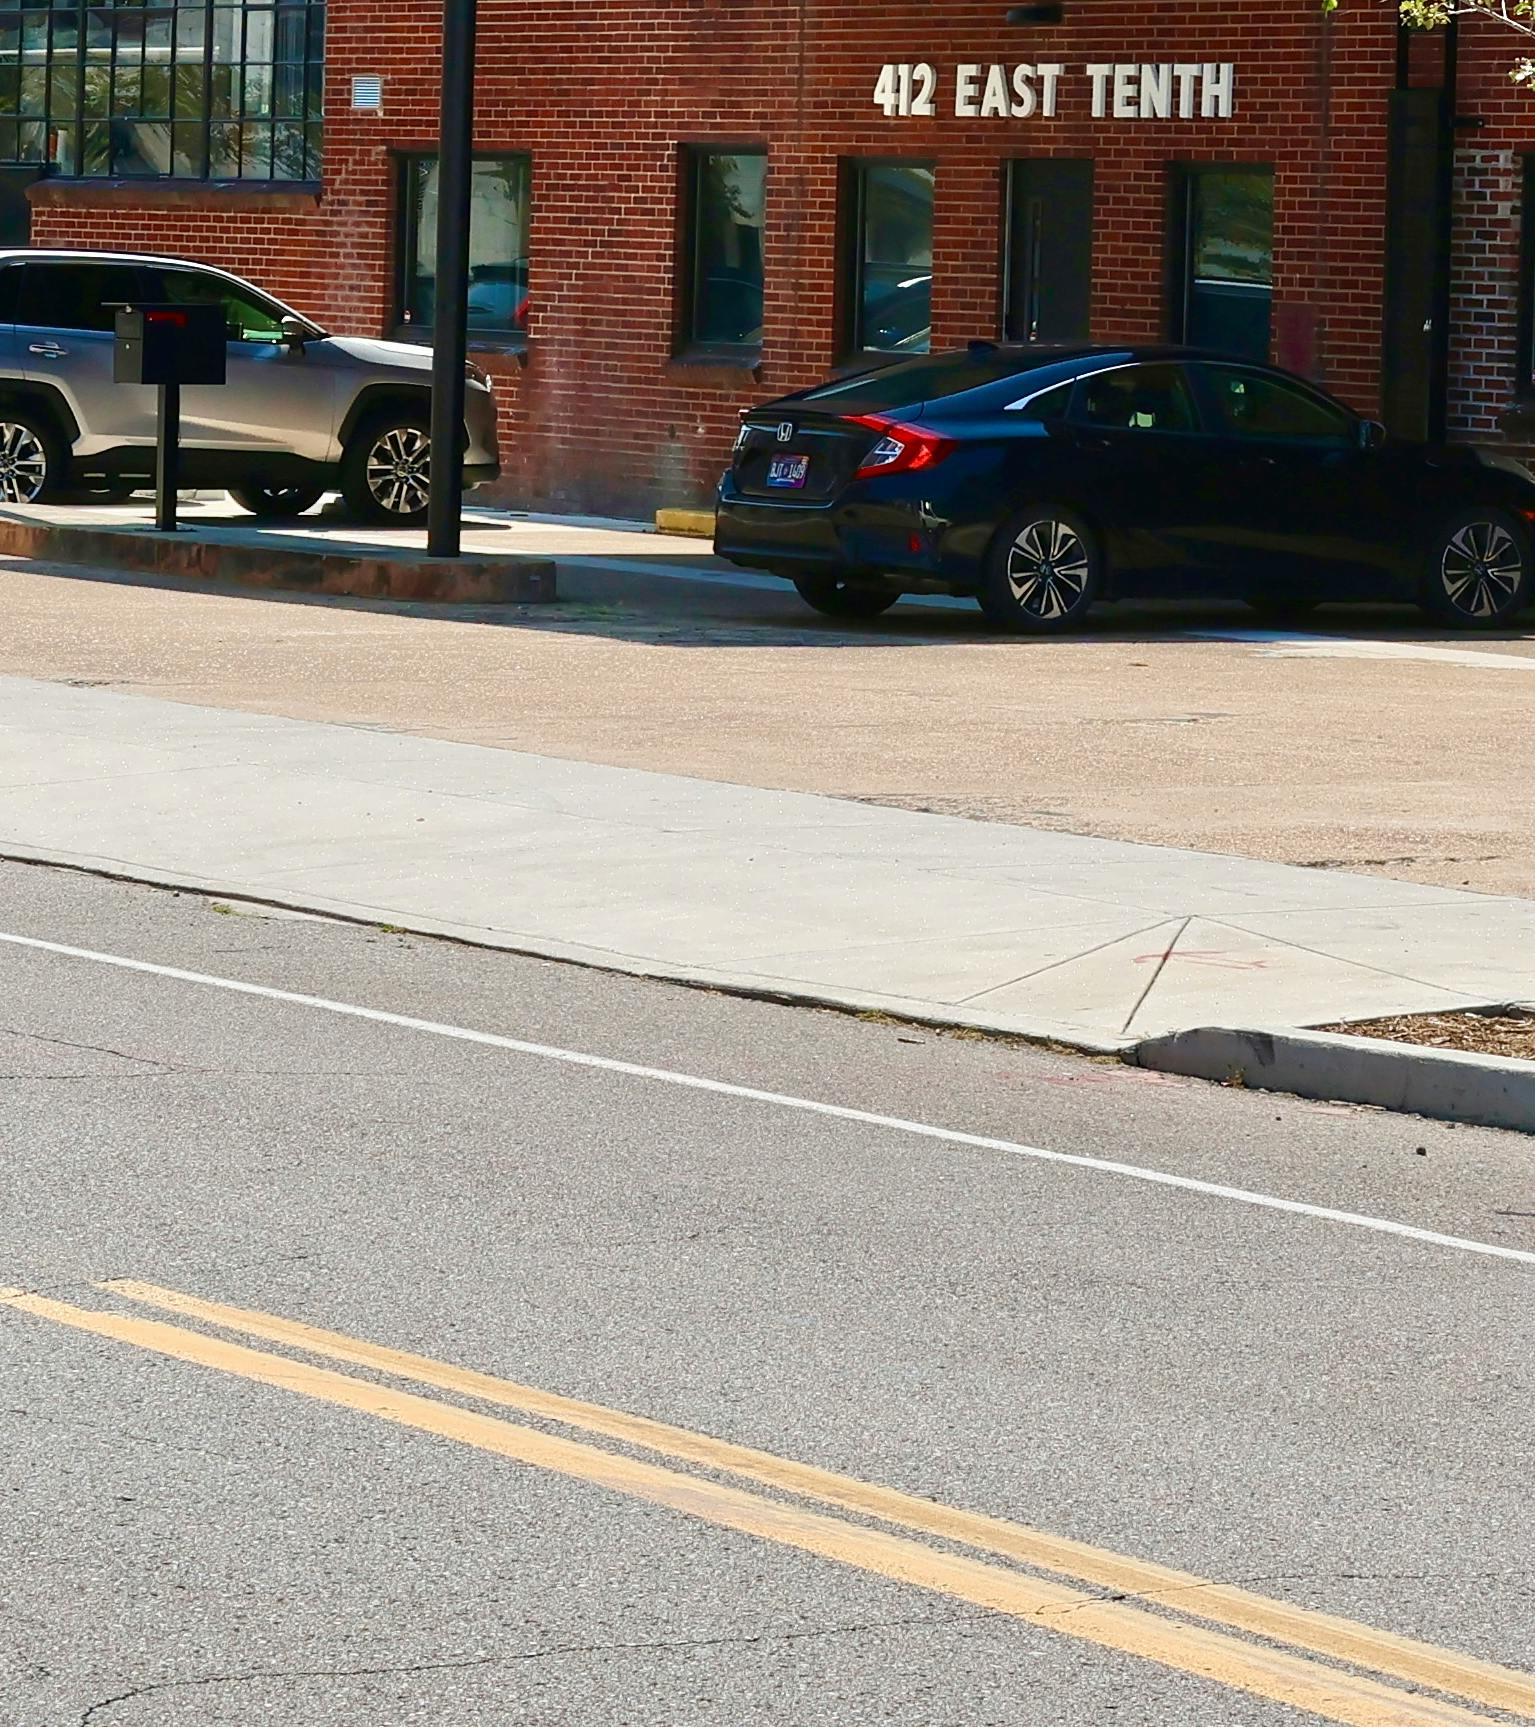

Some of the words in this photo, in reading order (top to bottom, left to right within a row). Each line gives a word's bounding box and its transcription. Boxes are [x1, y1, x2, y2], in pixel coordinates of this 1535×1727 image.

[873, 62, 938, 117] 412
[954, 63, 1064, 118] EAST
[1086, 63, 1234, 119] TENTH
